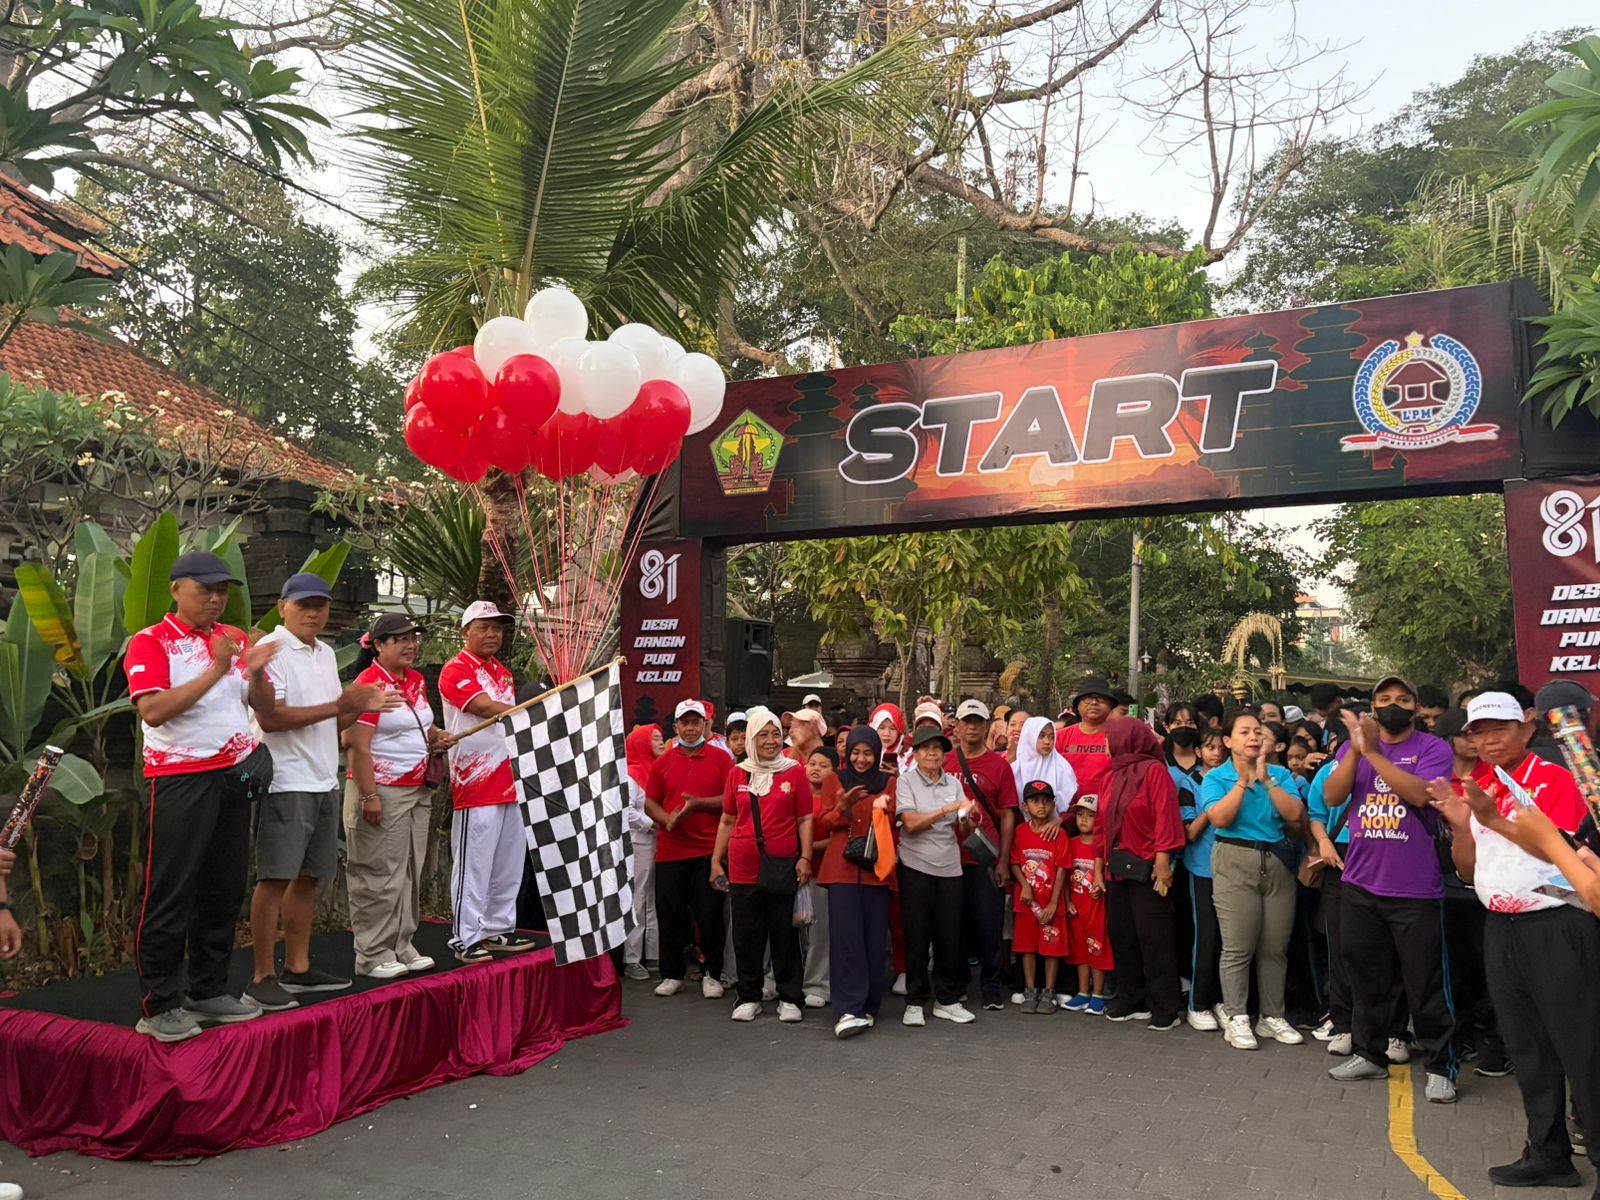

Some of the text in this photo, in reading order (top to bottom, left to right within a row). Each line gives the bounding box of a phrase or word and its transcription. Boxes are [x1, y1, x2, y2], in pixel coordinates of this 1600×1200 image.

[1403, 409, 1431, 420] LPM
[838, 360, 1278, 484] START
[639, 549, 682, 605] 81
[641, 619, 679, 631] DESA
[633, 636, 686, 648] DANGIN
[642, 653, 676, 665] PURI
[1549, 655, 1600, 672] KEL
[636, 670, 682, 683] KELOD
[1366, 793, 1400, 806] END
[1358, 804, 1407, 818] POLIO
[1361, 816, 1401, 829] NOW
[1364, 829, 1384, 838] AIA
